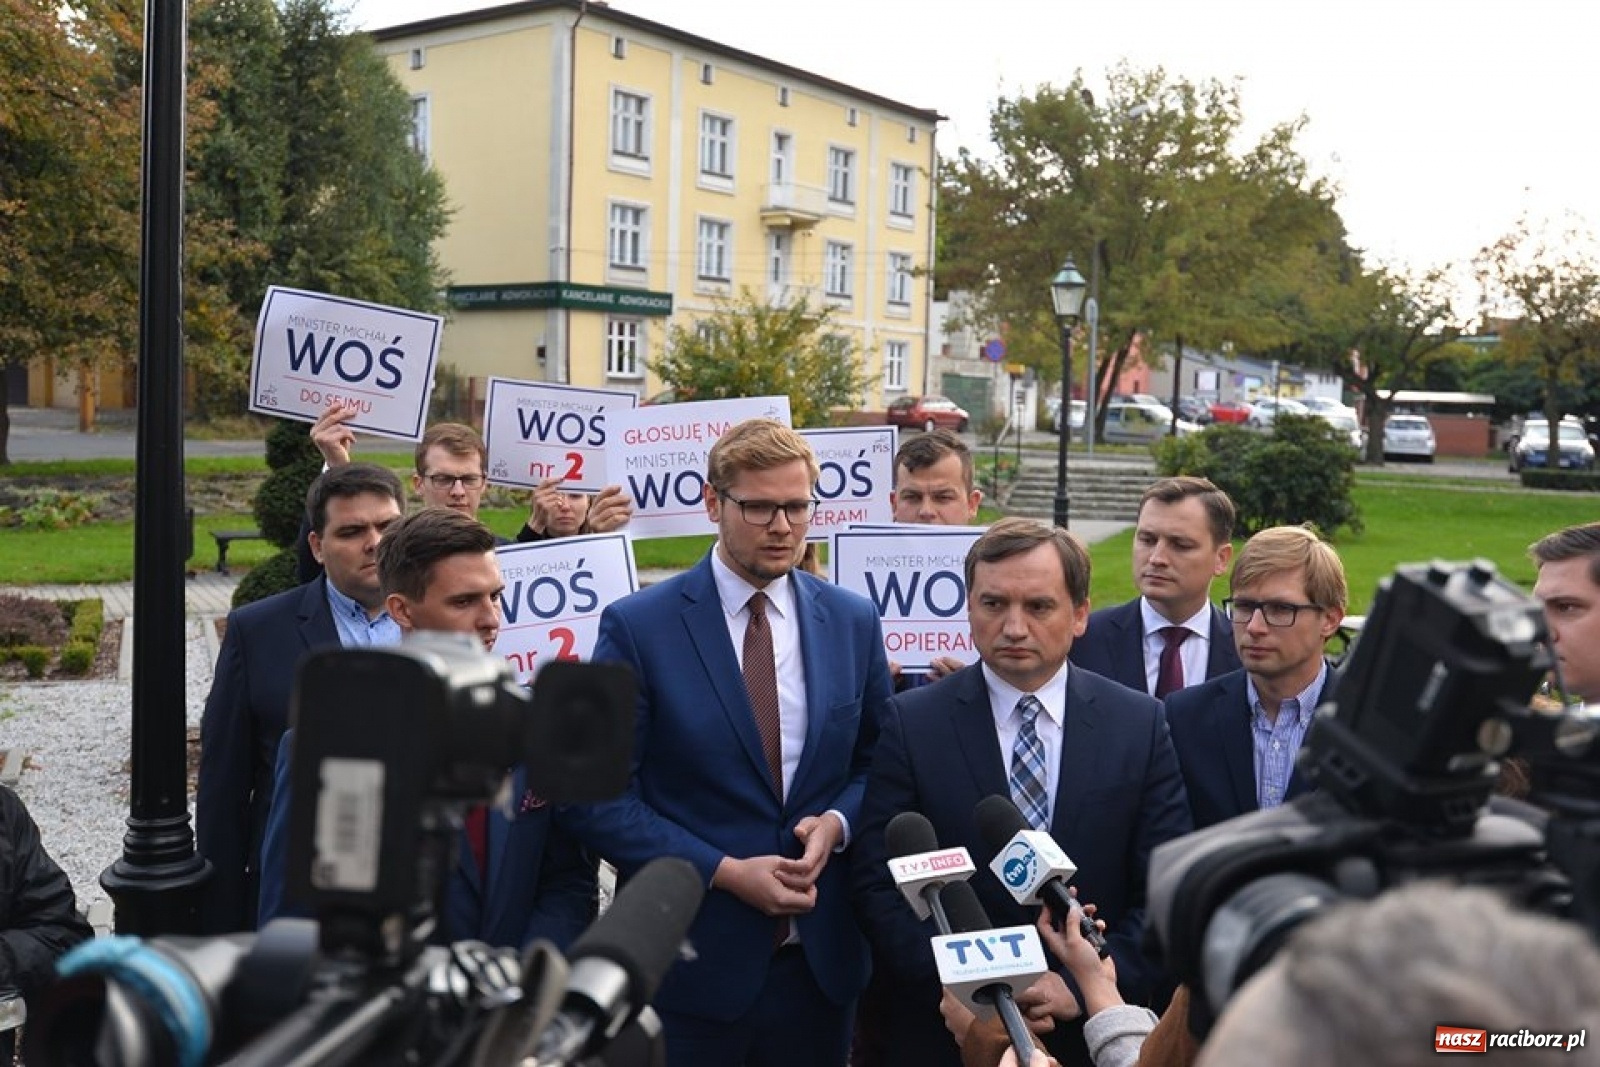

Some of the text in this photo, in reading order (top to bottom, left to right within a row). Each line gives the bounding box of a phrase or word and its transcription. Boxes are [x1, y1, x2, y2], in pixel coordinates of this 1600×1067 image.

[288, 314, 388, 344] MINISTER MICHAŁ
[287, 328, 405, 389] WOŚ
[300, 388, 372, 414] DO SEJMU
[517, 406, 606, 446] WOŚ
[624, 421, 733, 446] GŁOSUJĘ NA
[529, 452, 584, 480] nr 2
[626, 451, 698, 471] MINISTRA
[814, 449, 873, 499] OŚ
[628, 470, 705, 509] WO
[526, 561, 574, 577] MICHAŁ
[866, 555, 966, 568] MINISTER MICH
[864, 570, 966, 618] WO
[505, 626, 581, 673] nr 2
[885, 631, 976, 653] OPIERA
[931, 854, 965, 870] INFO
